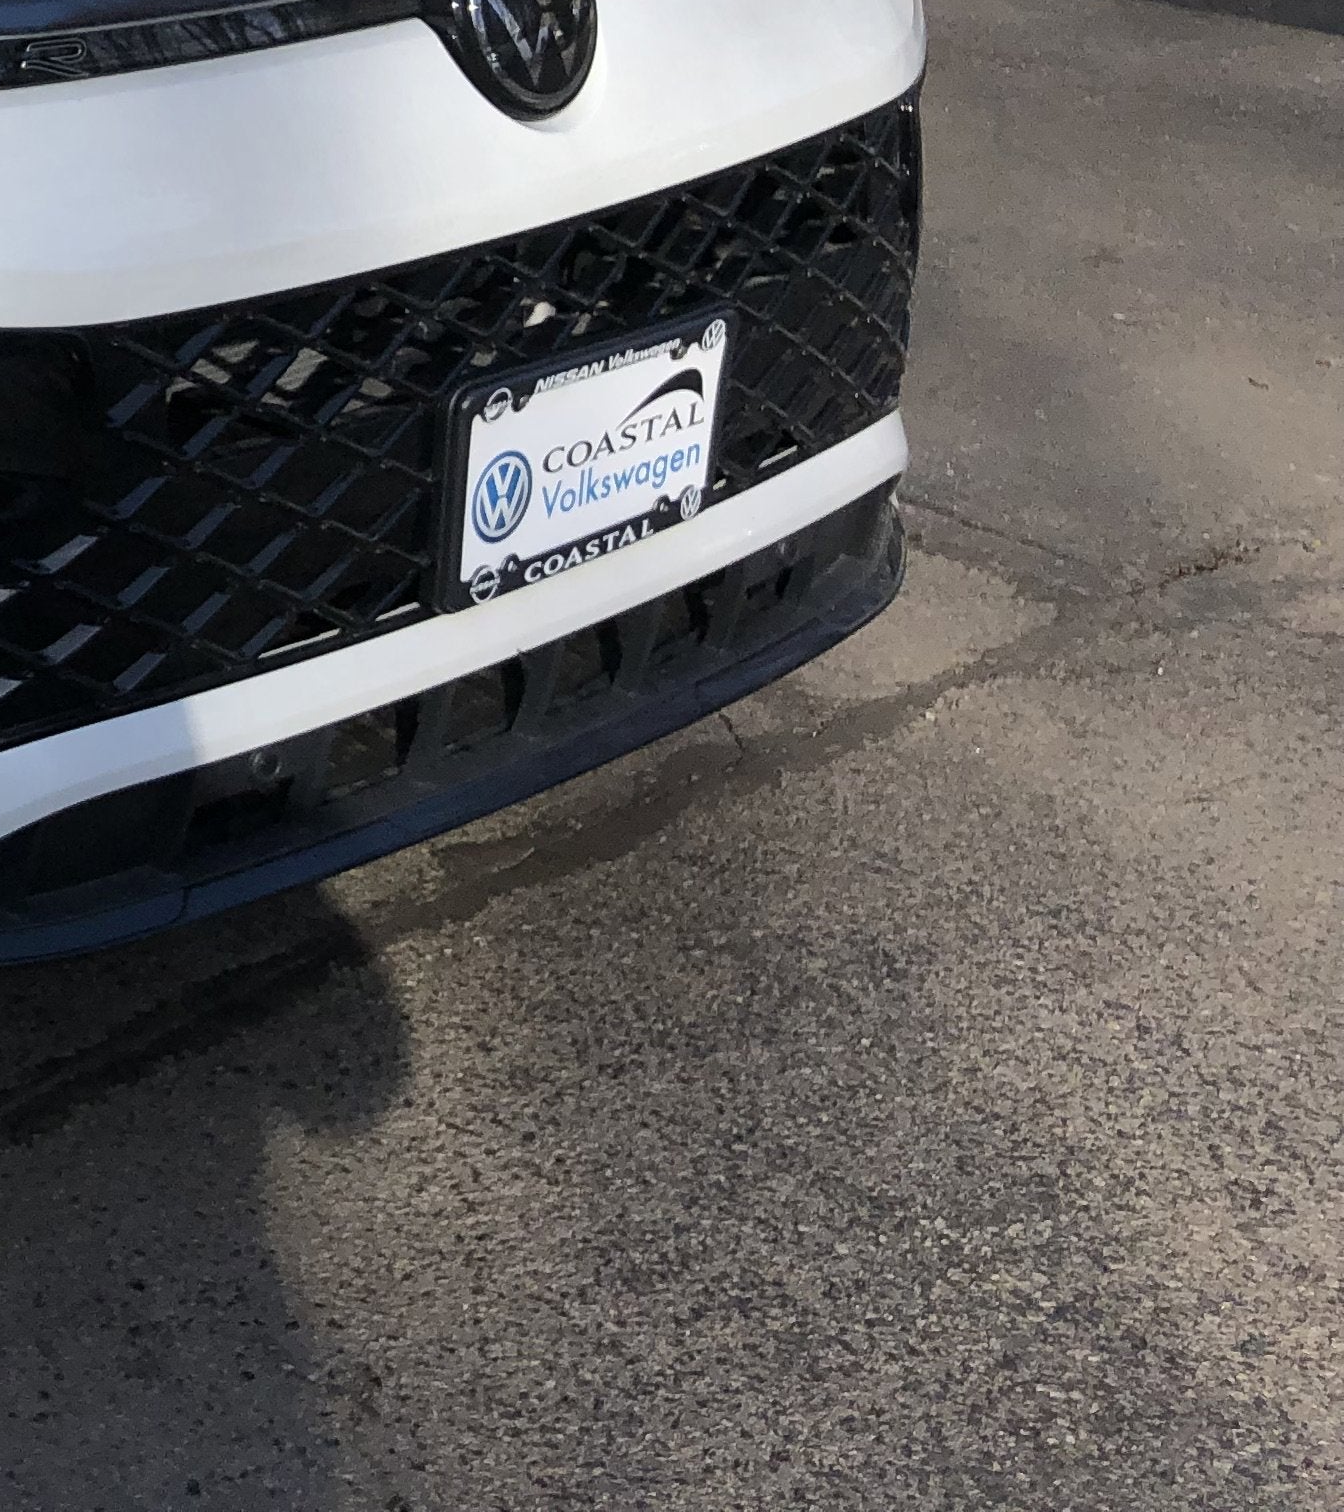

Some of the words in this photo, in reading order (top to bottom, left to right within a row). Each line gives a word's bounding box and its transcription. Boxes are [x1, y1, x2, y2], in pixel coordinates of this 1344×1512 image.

[534, 360, 604, 394] NISSAN
[542, 401, 705, 473] COASTAL
[541, 442, 701, 519] Volkswagen
[523, 518, 655, 584] COASTAL
